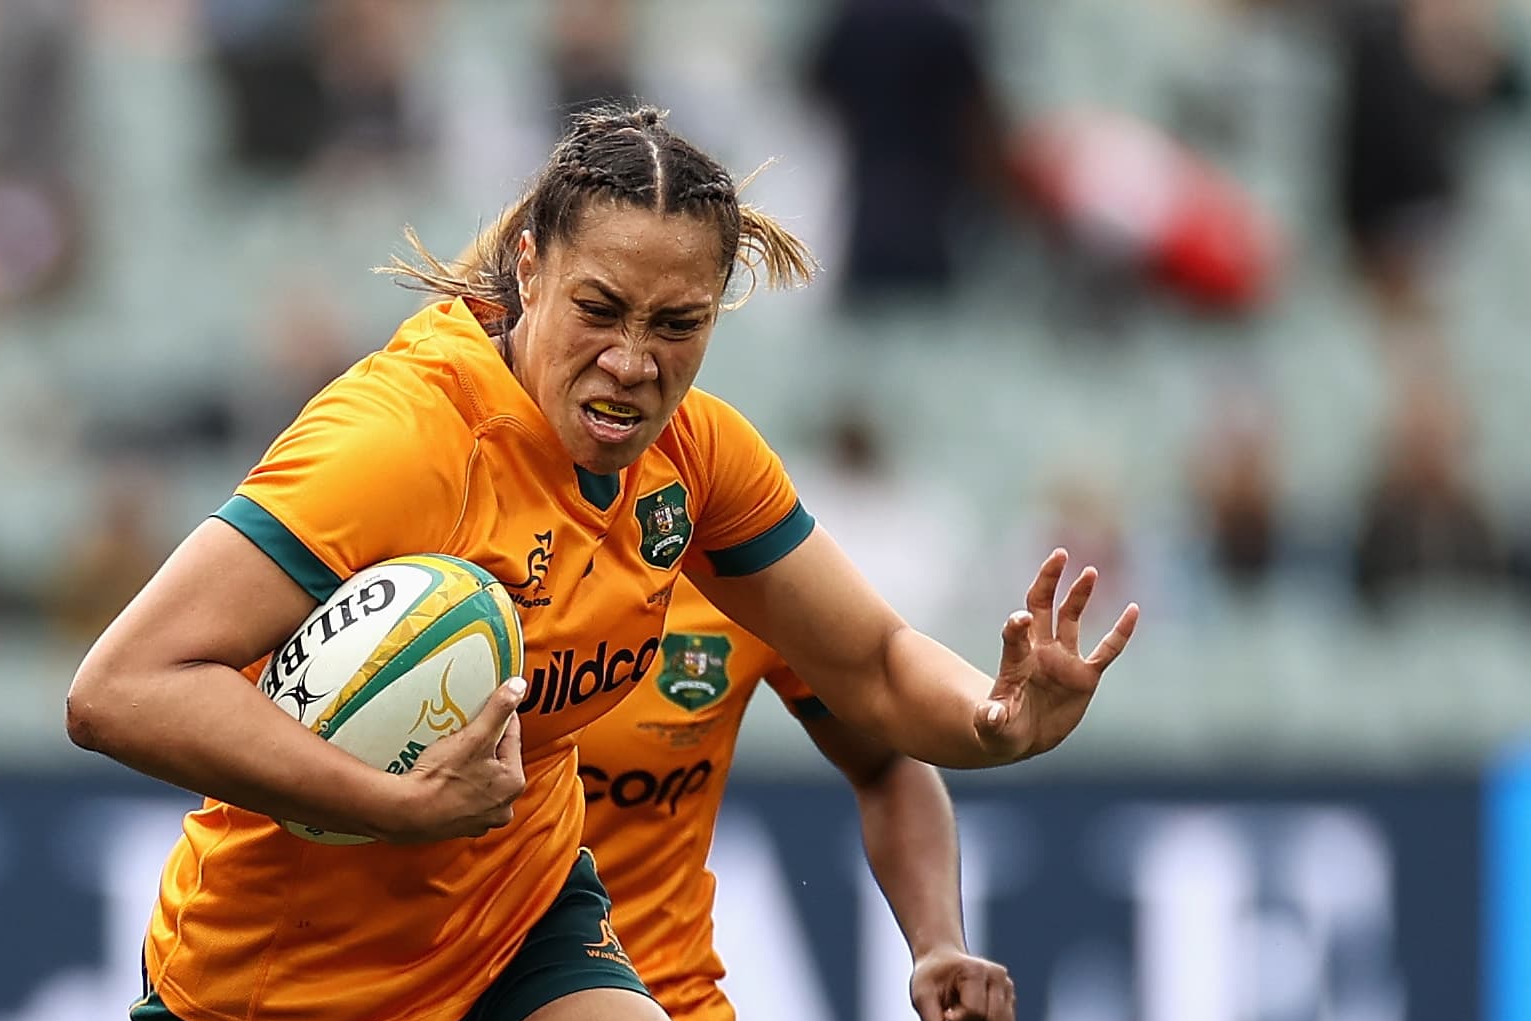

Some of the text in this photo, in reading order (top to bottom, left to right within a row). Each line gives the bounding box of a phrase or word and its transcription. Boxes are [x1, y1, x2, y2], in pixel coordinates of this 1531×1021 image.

[262, 578, 396, 700] GILBE
[516, 636, 660, 715] uildco
[578, 759, 713, 816] corp
